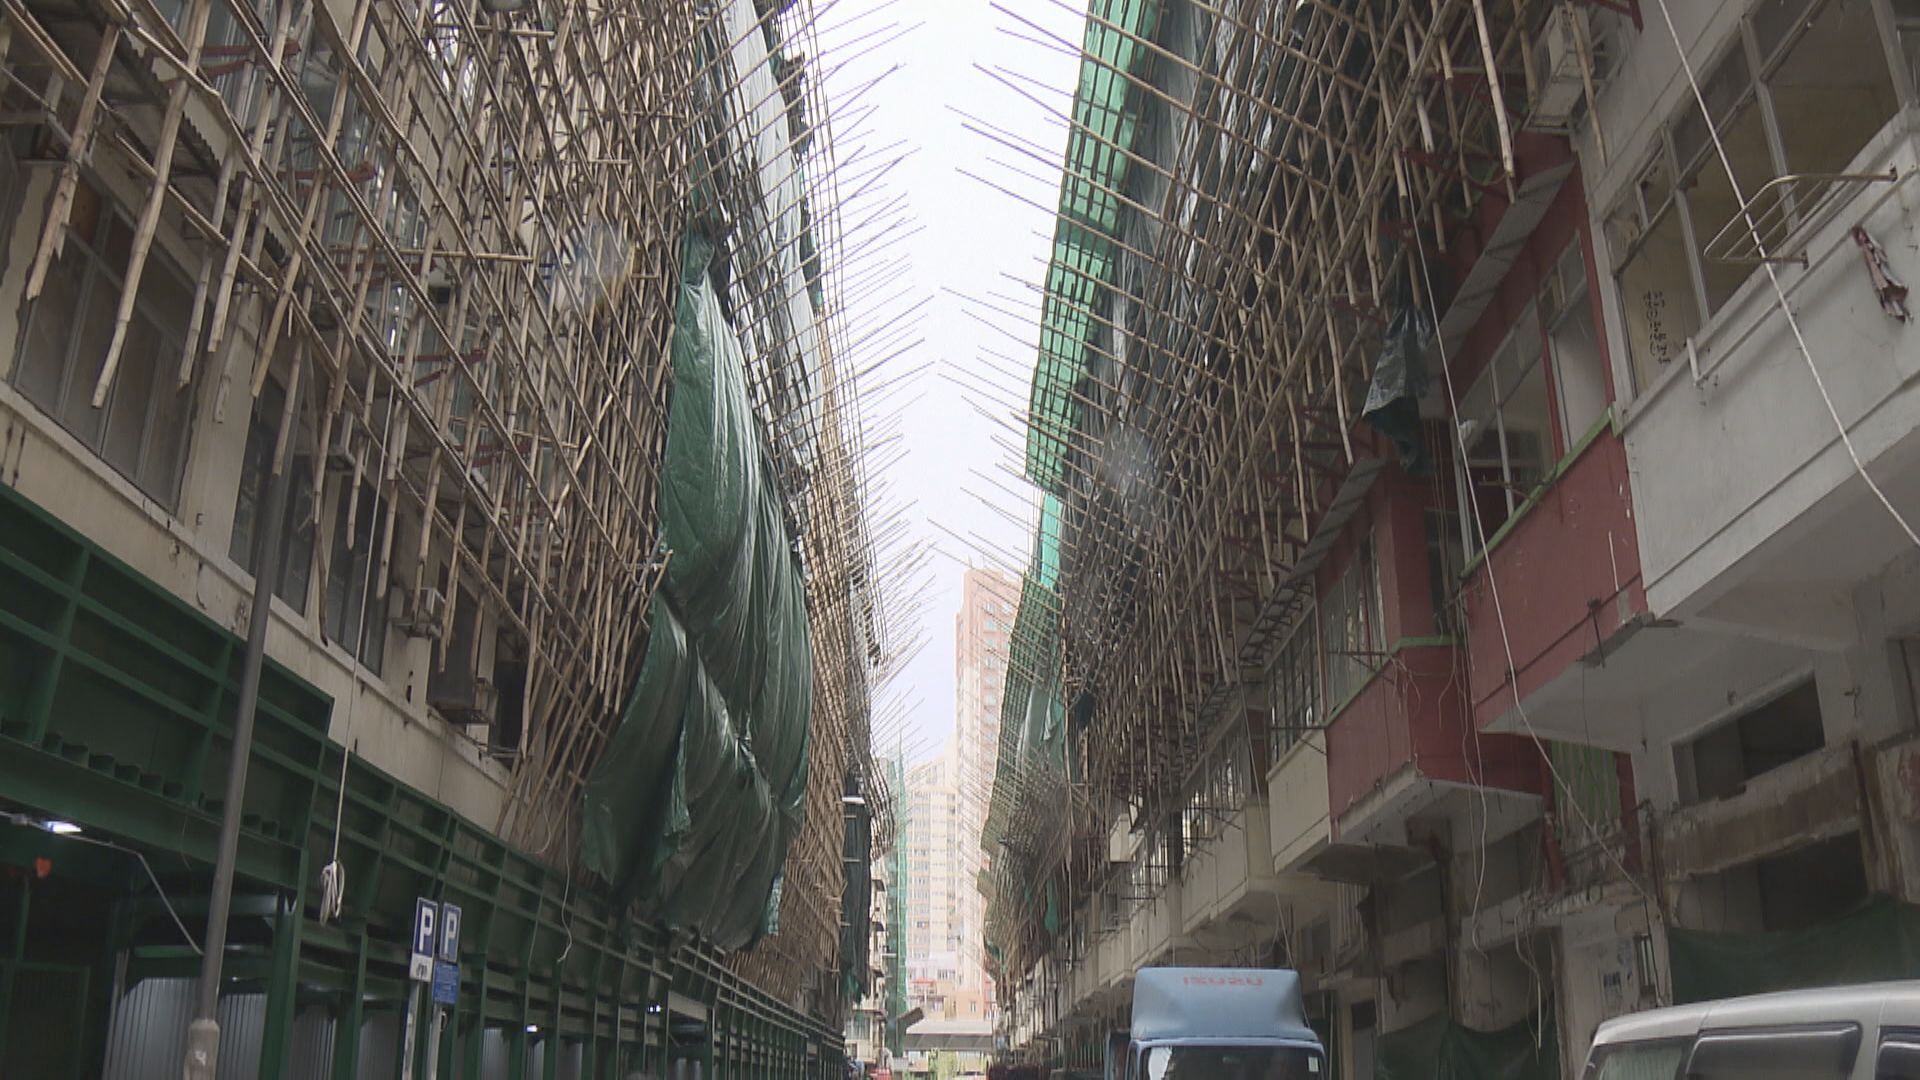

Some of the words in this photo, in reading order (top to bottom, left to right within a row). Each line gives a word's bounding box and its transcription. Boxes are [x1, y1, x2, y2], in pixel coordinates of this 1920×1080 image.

[419, 907, 434, 952] P
[445, 913, 458, 954] P
[1183, 976, 1264, 986] ISUZU
